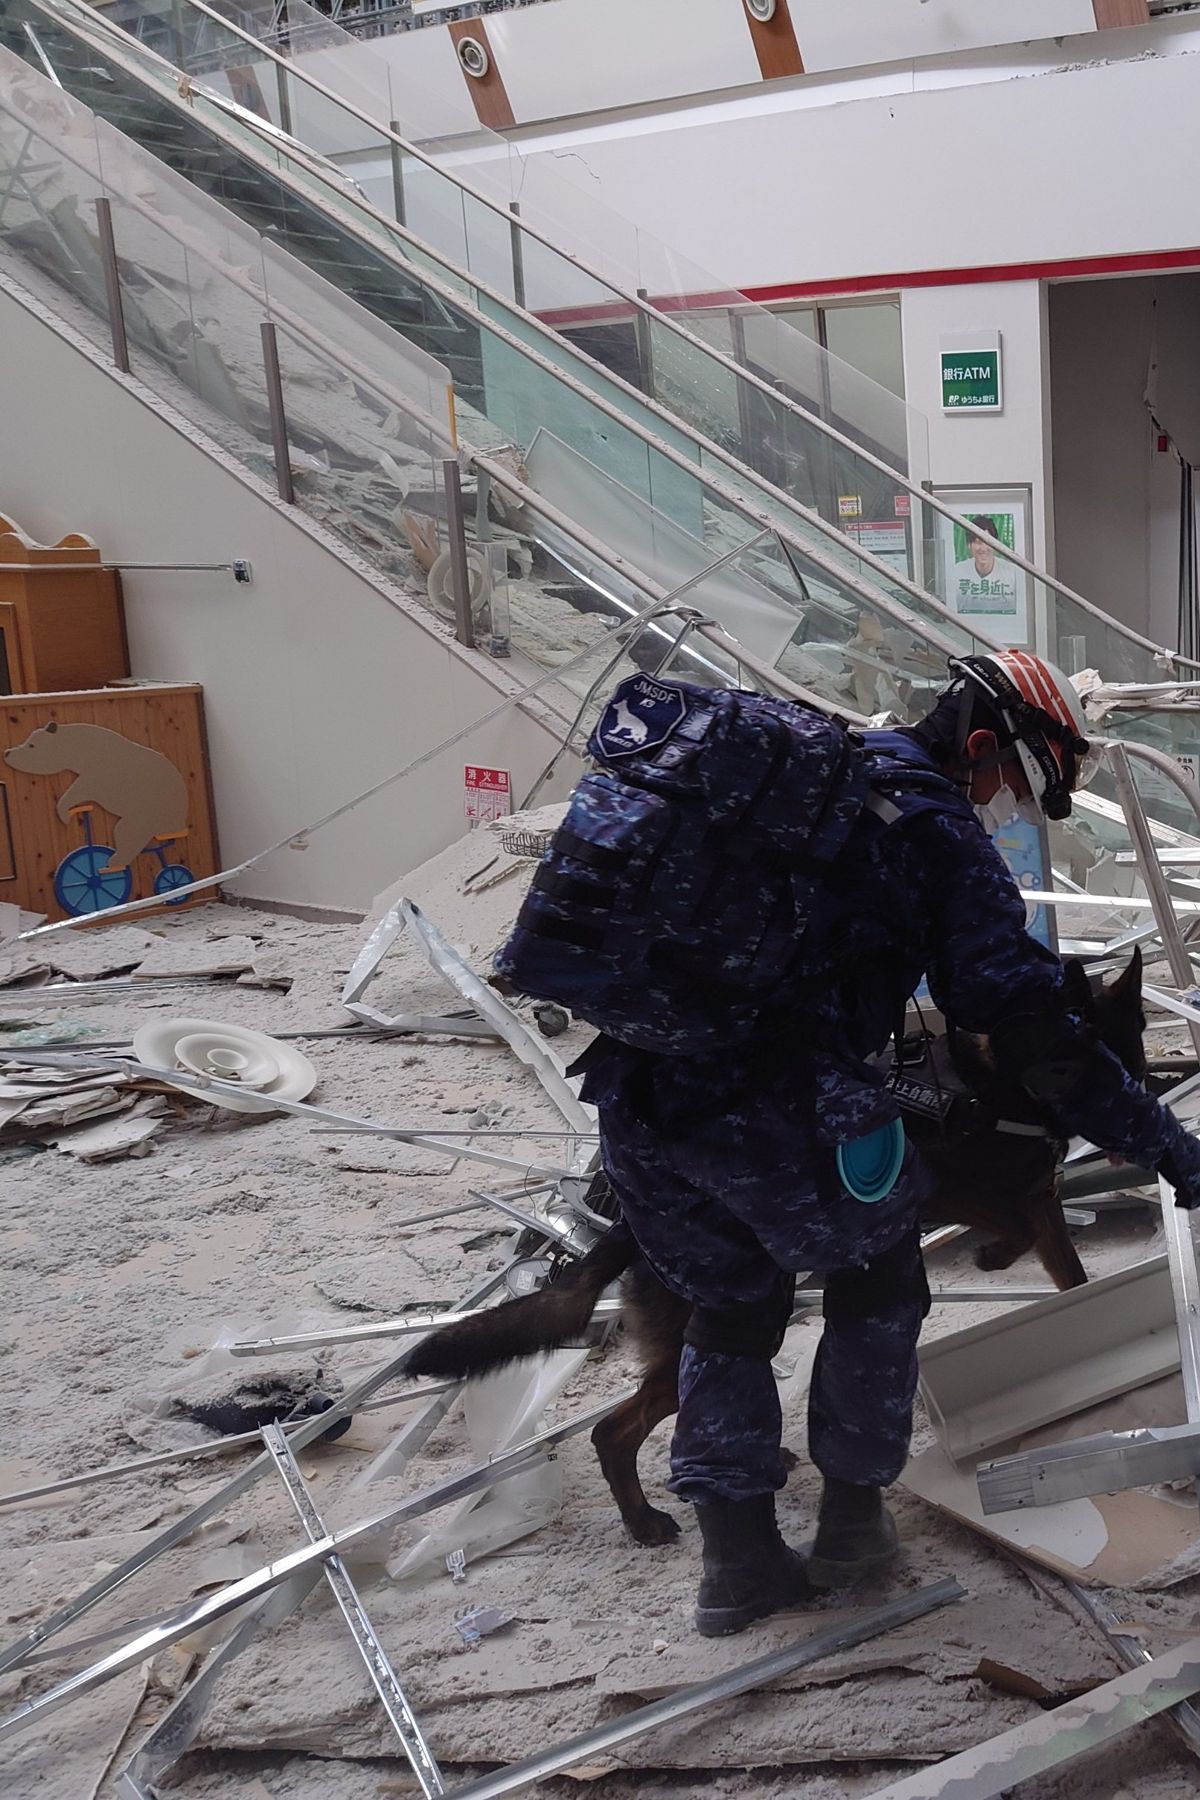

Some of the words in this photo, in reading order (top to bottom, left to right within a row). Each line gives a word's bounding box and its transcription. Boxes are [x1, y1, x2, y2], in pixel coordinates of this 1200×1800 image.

[943, 366, 991, 381] 銀行ATM
[961, 394, 995, 404] ゆうちょ銀行
[958, 578, 1014, 597] 夢を身近に。
[634, 680, 677, 704] JMSDF
[467, 768, 507, 784] 消火器
